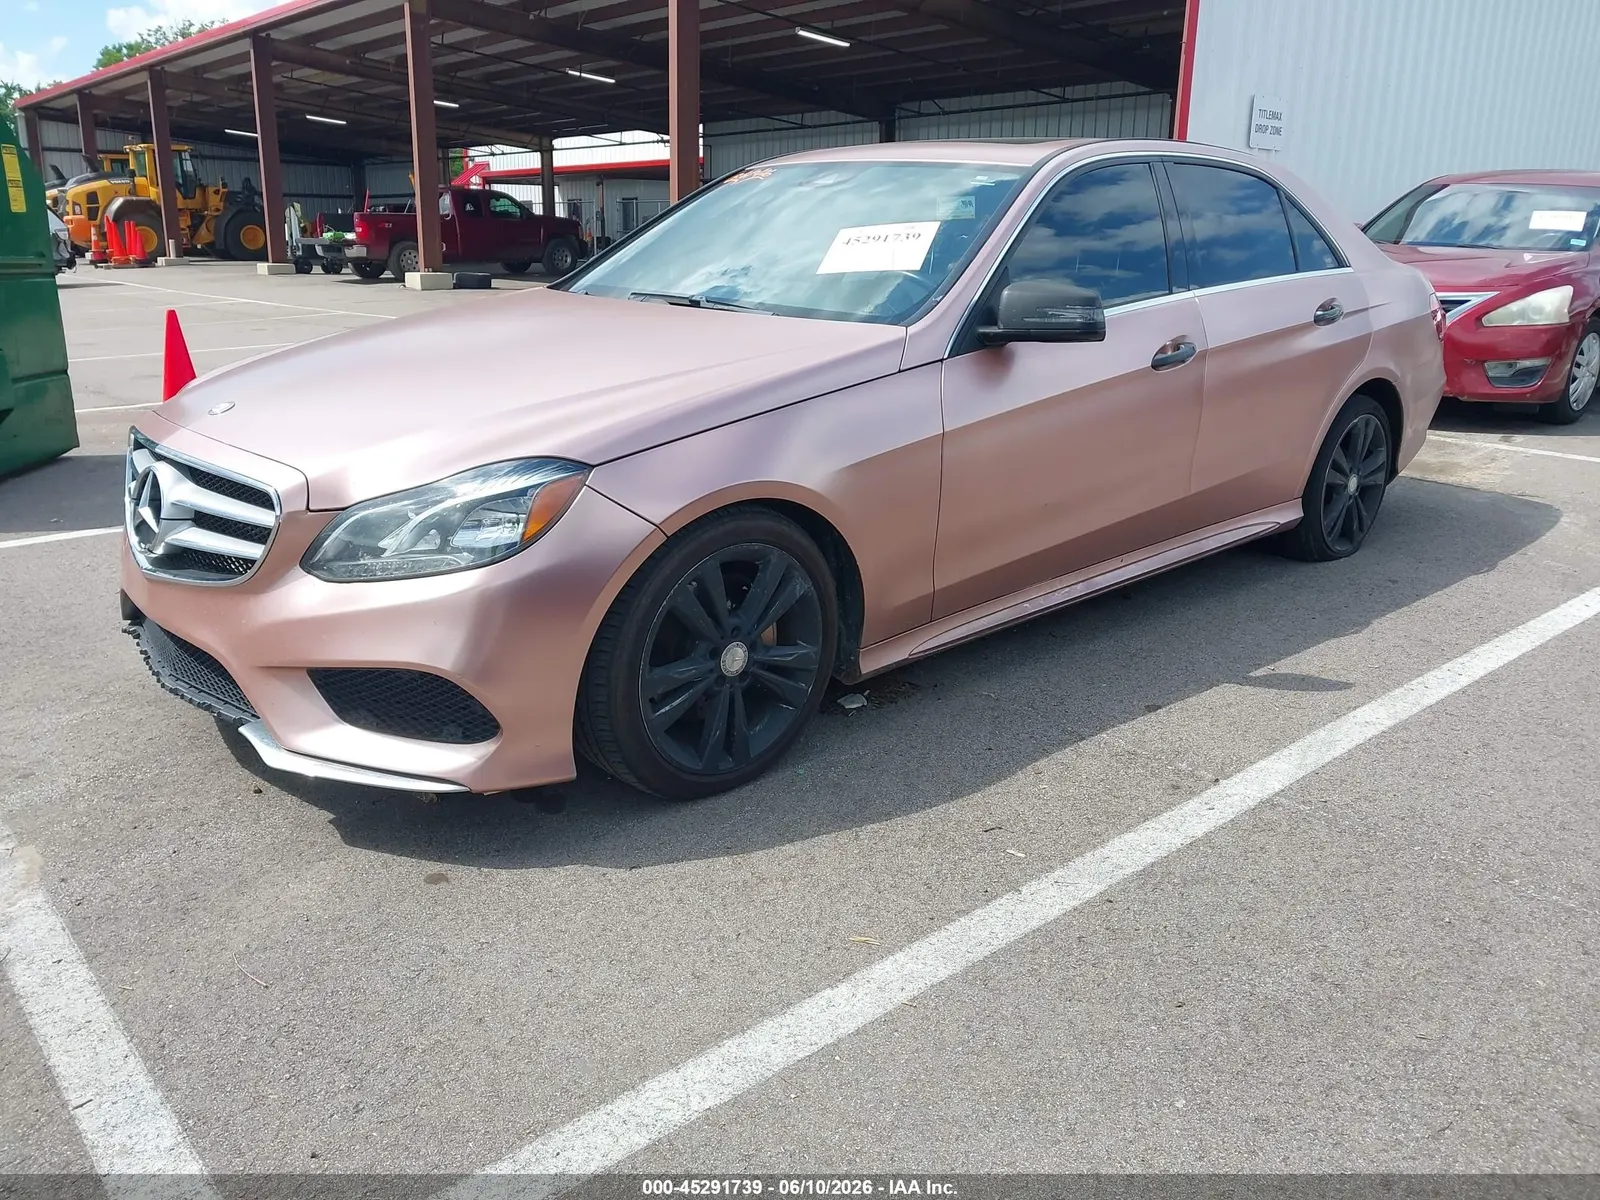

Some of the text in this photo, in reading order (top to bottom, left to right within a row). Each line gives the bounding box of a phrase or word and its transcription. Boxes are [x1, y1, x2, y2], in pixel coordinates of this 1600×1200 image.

[1258, 108, 1283, 121] TITLEMAX
[1254, 123, 1283, 136] DROP ZONE
